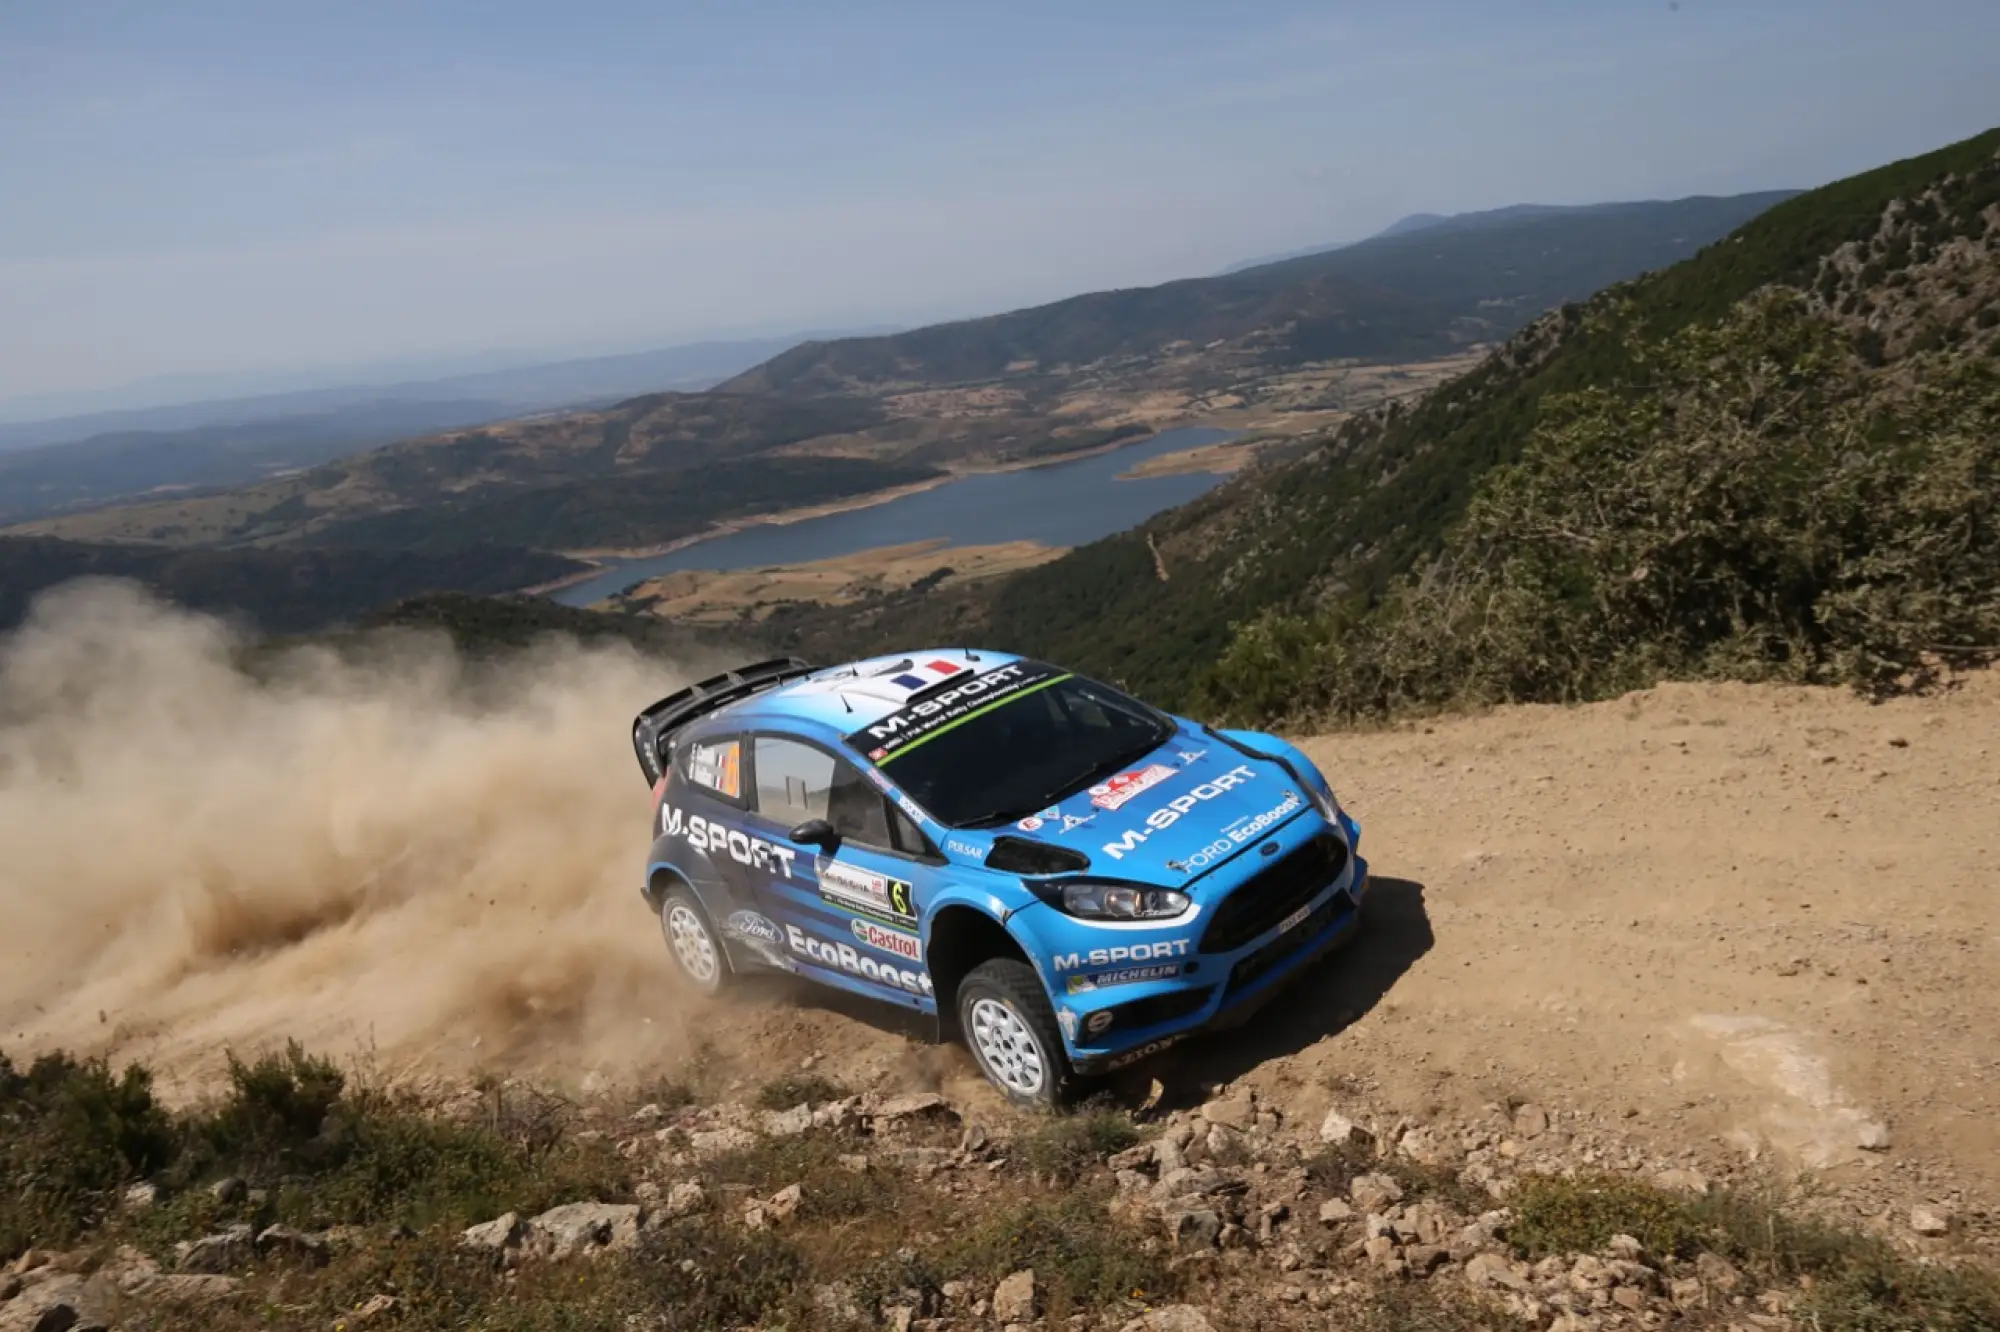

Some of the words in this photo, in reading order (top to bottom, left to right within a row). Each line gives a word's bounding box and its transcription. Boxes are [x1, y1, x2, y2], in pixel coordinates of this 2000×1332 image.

[868, 664, 1023, 740] M-SPORT
[1102, 764, 1257, 860] M-SPORT
[661, 802, 796, 880] M-SPORT
[947, 839, 984, 859] PULSAR
[892, 882, 908, 916] 6
[868, 926, 919, 959] Castrol
[1053, 938, 1190, 972] M-SPORT
[785, 923, 935, 997] EcoBoost
[1096, 964, 1178, 984] MICHELIN
